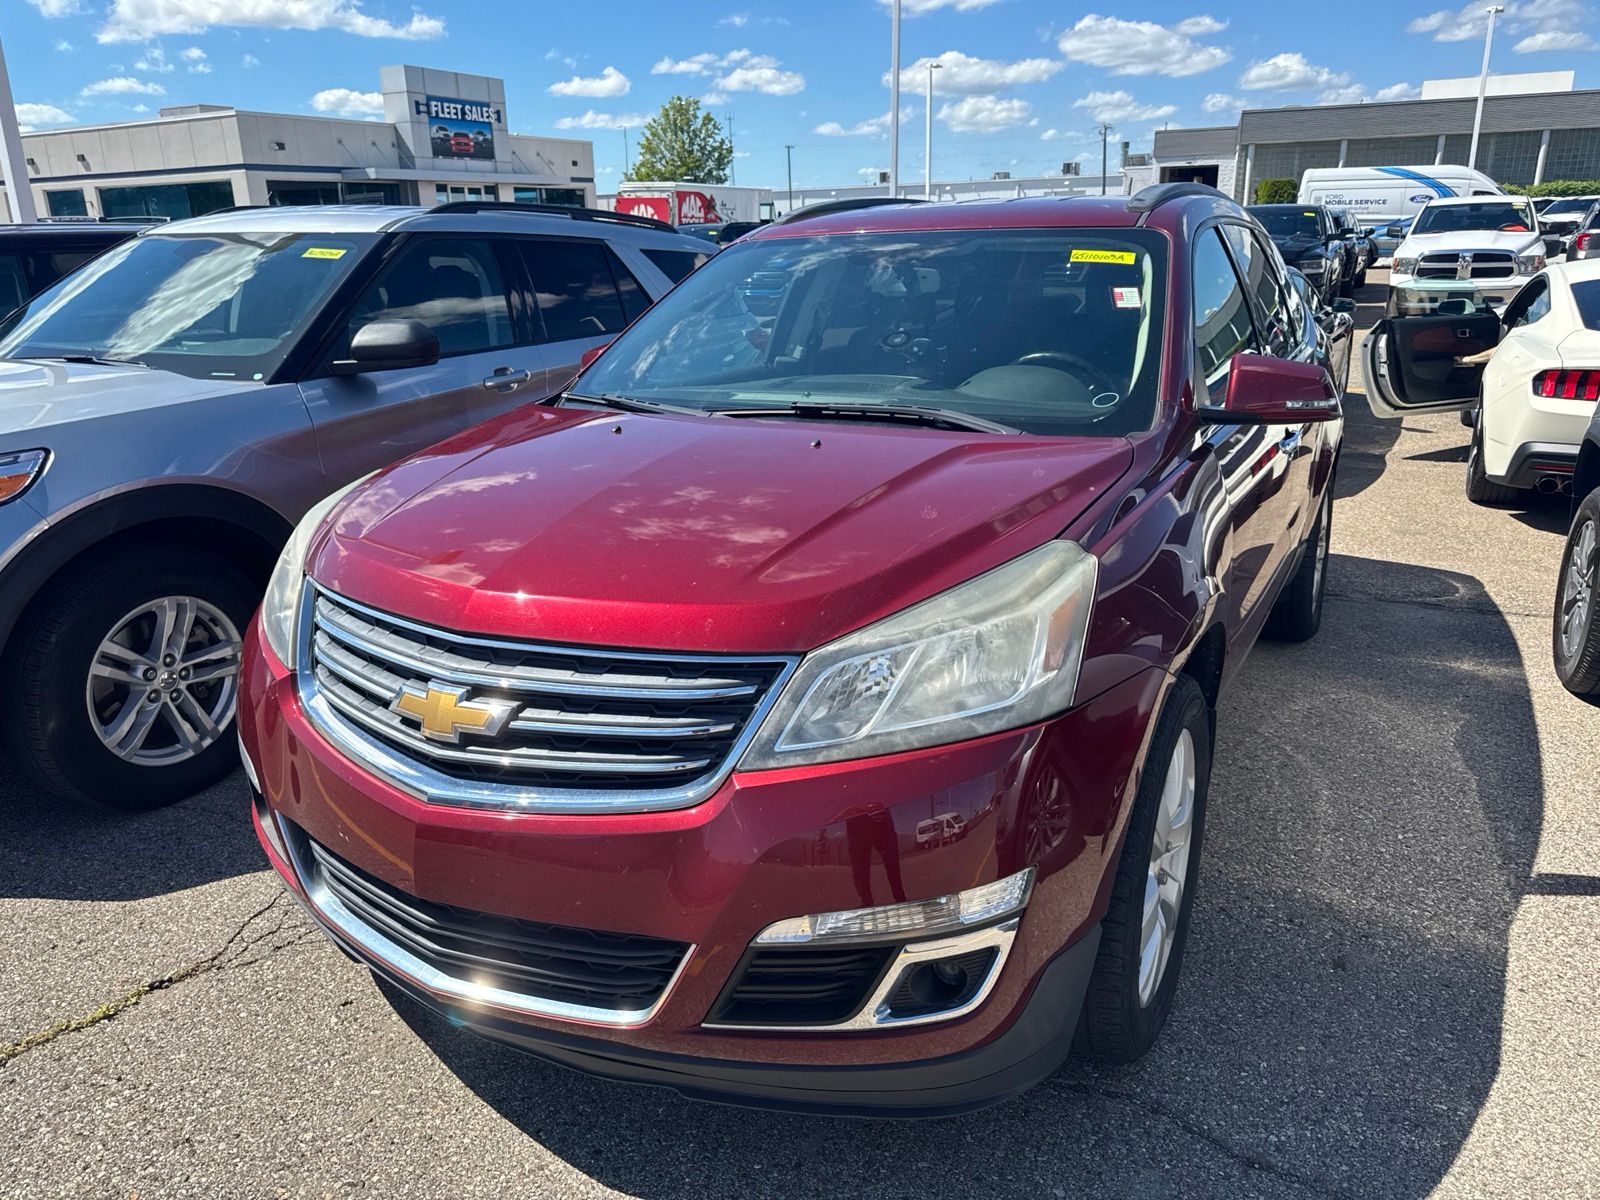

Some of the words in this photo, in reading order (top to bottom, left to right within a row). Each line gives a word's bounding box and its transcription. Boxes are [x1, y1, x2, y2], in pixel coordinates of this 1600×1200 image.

[430, 101, 462, 120] FLEET
[464, 105, 495, 123] SALES
[680, 194, 705, 218] MAC
